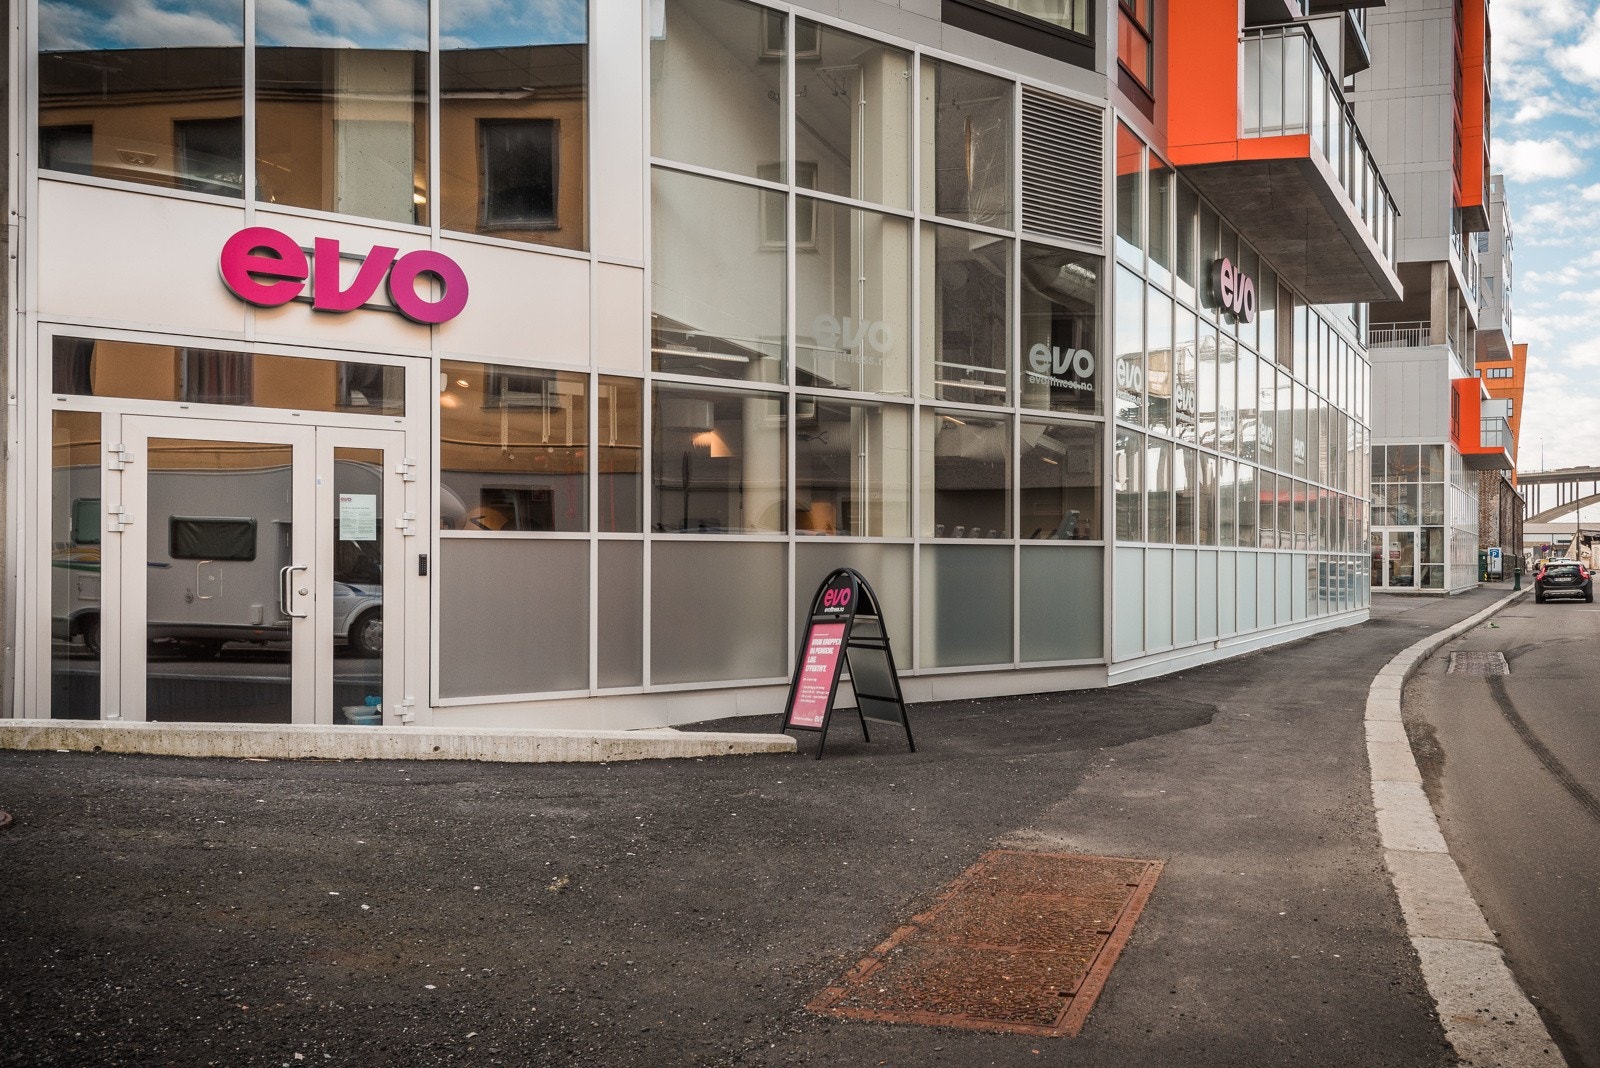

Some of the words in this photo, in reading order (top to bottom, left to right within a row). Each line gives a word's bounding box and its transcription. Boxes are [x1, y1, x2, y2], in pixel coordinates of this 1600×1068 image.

[220, 227, 470, 325] evo
[1220, 257, 1256, 324] evo
[813, 313, 895, 353] evo
[1029, 342, 1095, 379] evo
[1117, 358, 1142, 393] evo
[1176, 384, 1196, 414] evo
[824, 588, 851, 606] evo
